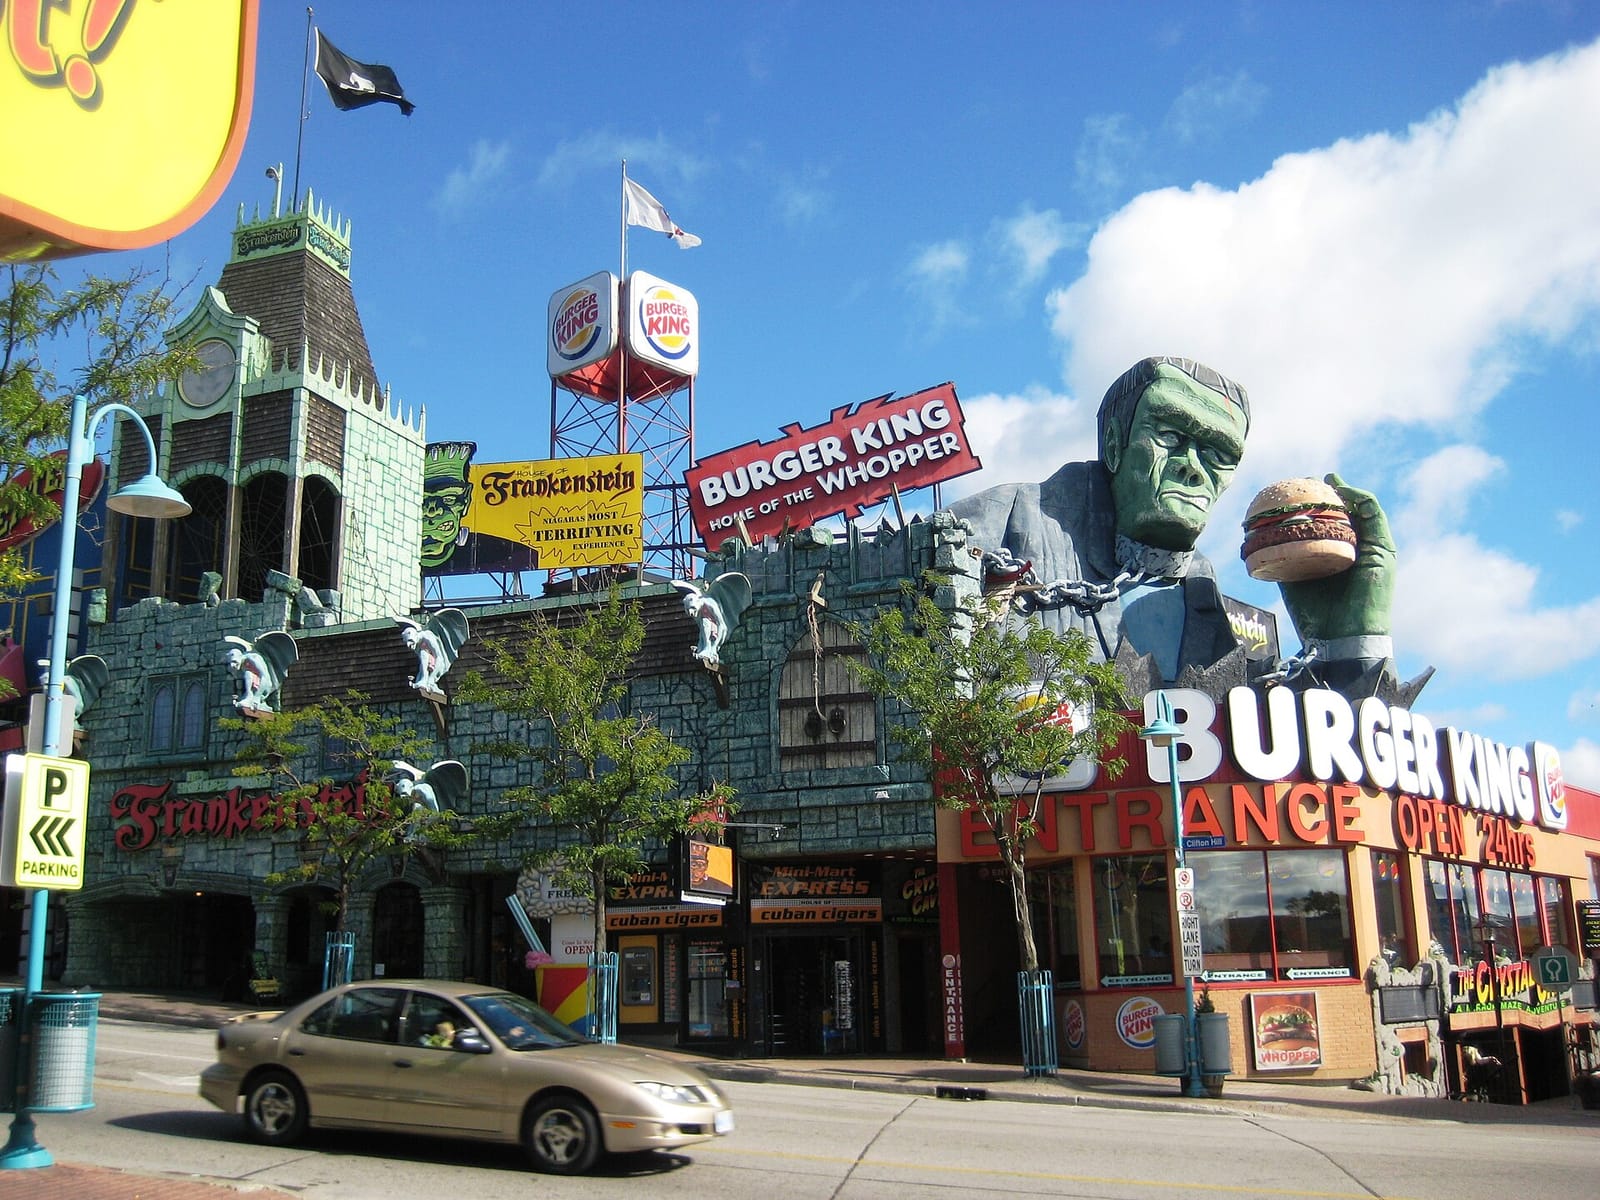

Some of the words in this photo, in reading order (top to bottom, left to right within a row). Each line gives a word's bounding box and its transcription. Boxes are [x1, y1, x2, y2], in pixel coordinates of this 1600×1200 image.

[556, 292, 597, 332] BURGER
[646, 302, 688, 317] BURGER
[557, 304, 599, 350] KING
[647, 315, 690, 336] KING
[699, 435, 848, 507] BURGER
[850, 399, 951, 455] KING
[481, 461, 635, 506] Frankenstein
[709, 507, 756, 532] HOME
[758, 497, 780, 515] OF
[783, 486, 815, 507] THE
[816, 431, 961, 496] WHOPPER
[542, 516, 585, 525] NIAGARAS
[587, 511, 618, 521] MOST
[533, 523, 634, 542] TERRIFYING
[572, 540, 625, 551] EXPERIENCE
[1143, 685, 1445, 801] BURGER
[1446, 725, 1535, 822] KING
[44, 767, 68, 807] P
[961, 782, 1365, 857] ENTRANCE
[1398, 795, 1467, 858] OPEN
[1481, 816, 1537, 868] 24hrs
[1186, 838, 1210, 848] Clifton
[1211, 837, 1223, 847] Hill
[22, 860, 78, 878] PARKING
[772, 866, 857, 878] Mini-Mart
[611, 885, 675, 900] EXPR
[760, 880, 870, 896] EXPRESS
[610, 914, 660, 927] cuban
[665, 913, 719, 927] cigars
[761, 908, 817, 921] cuban
[821, 907, 878, 922] cigars
[1182, 916, 1198, 929] RIGHT
[1183, 931, 1199, 943] LANE
[564, 945, 593, 955] OPEN
[1183, 945, 1200, 957] MUST
[1184, 959, 1201, 972] TURN
[1293, 969, 1350, 977] ENTRANCE
[1107, 975, 1173, 984] ENTRANCE
[1207, 970, 1266, 980] ENTRANCE
[1458, 968, 1475, 996] THE
[1476, 960, 1535, 1004] CYSTAL
[945, 969, 957, 1041] ENTRANCE
[1500, 1001, 1522, 1010] MAZE
[1122, 1006, 1159, 1025] BURGER
[1125, 1017, 1153, 1038] KIN
[1260, 1049, 1319, 1064] WHOPPER
